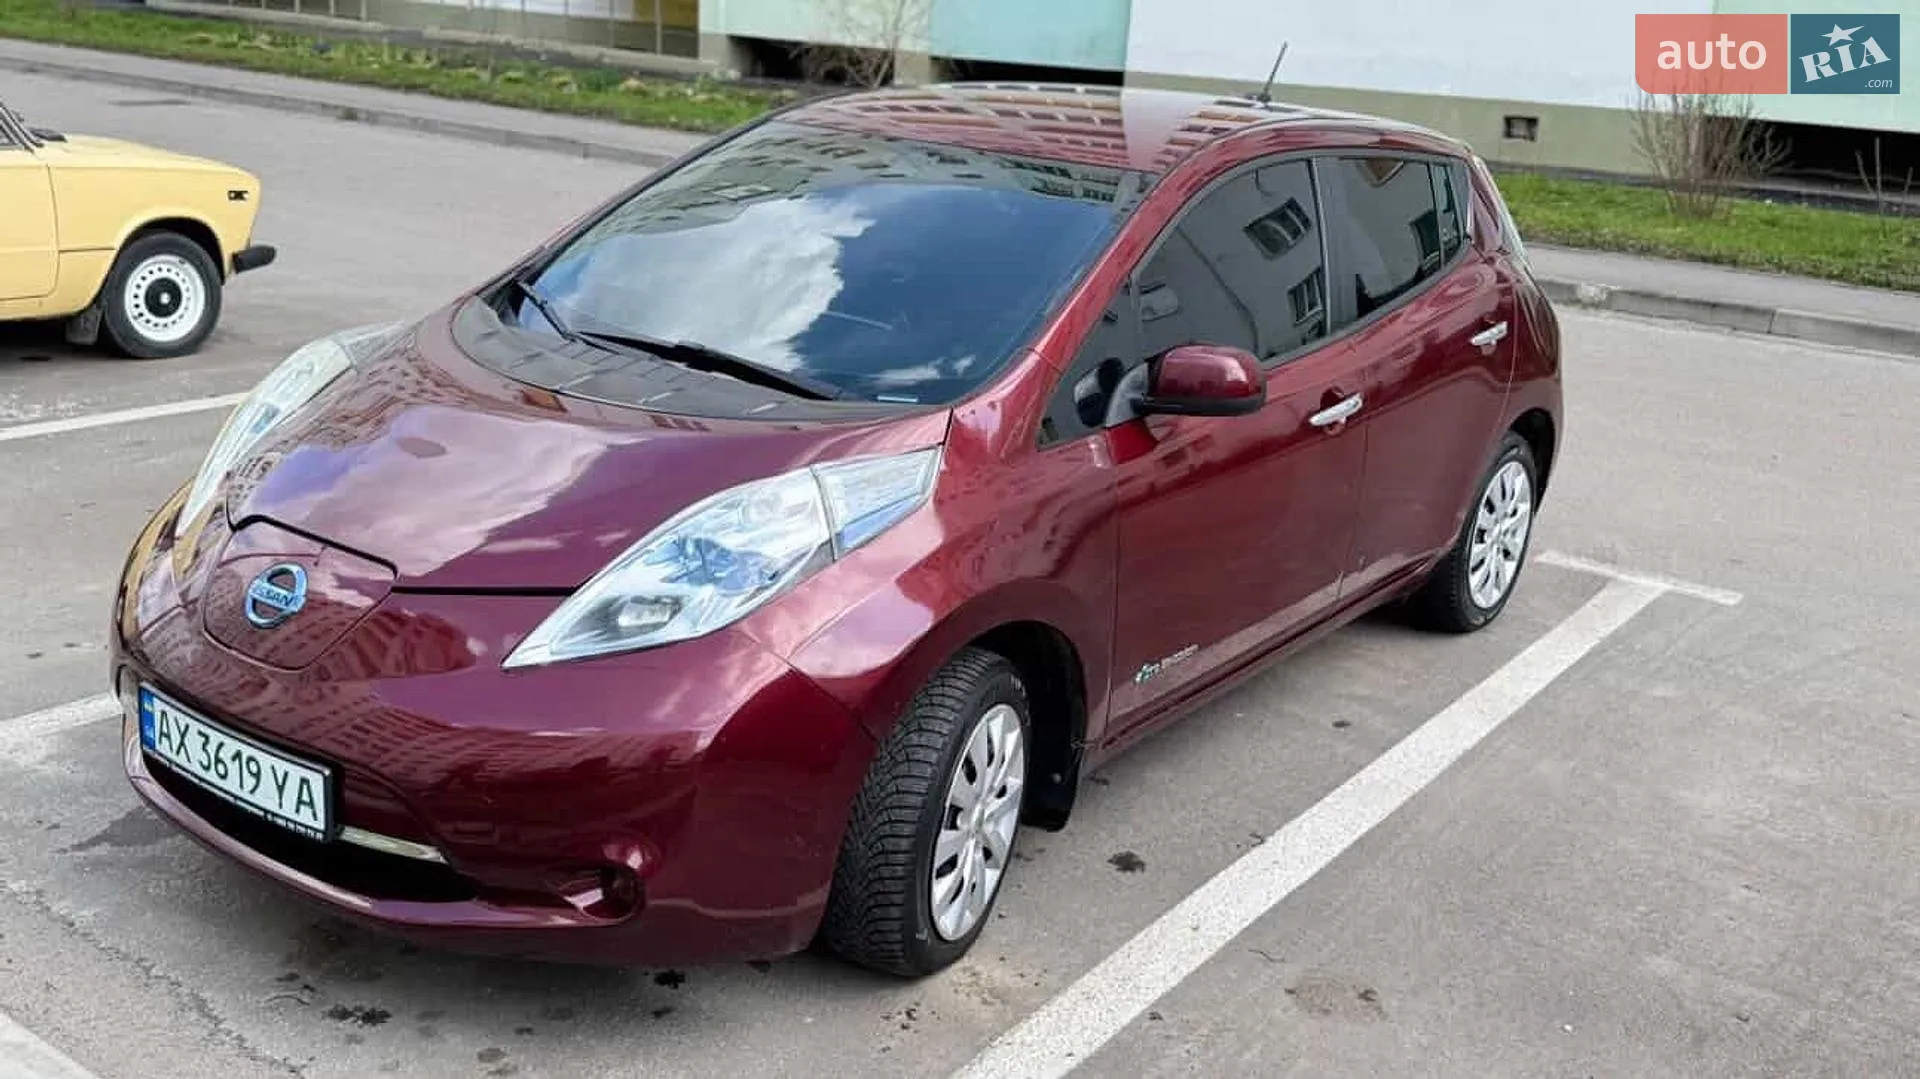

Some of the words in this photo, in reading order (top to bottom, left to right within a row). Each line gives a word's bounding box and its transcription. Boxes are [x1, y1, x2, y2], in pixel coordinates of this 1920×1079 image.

[158, 710, 191, 763] AX
[197, 730, 262, 794] 3619
[271, 765, 318, 821] YA
